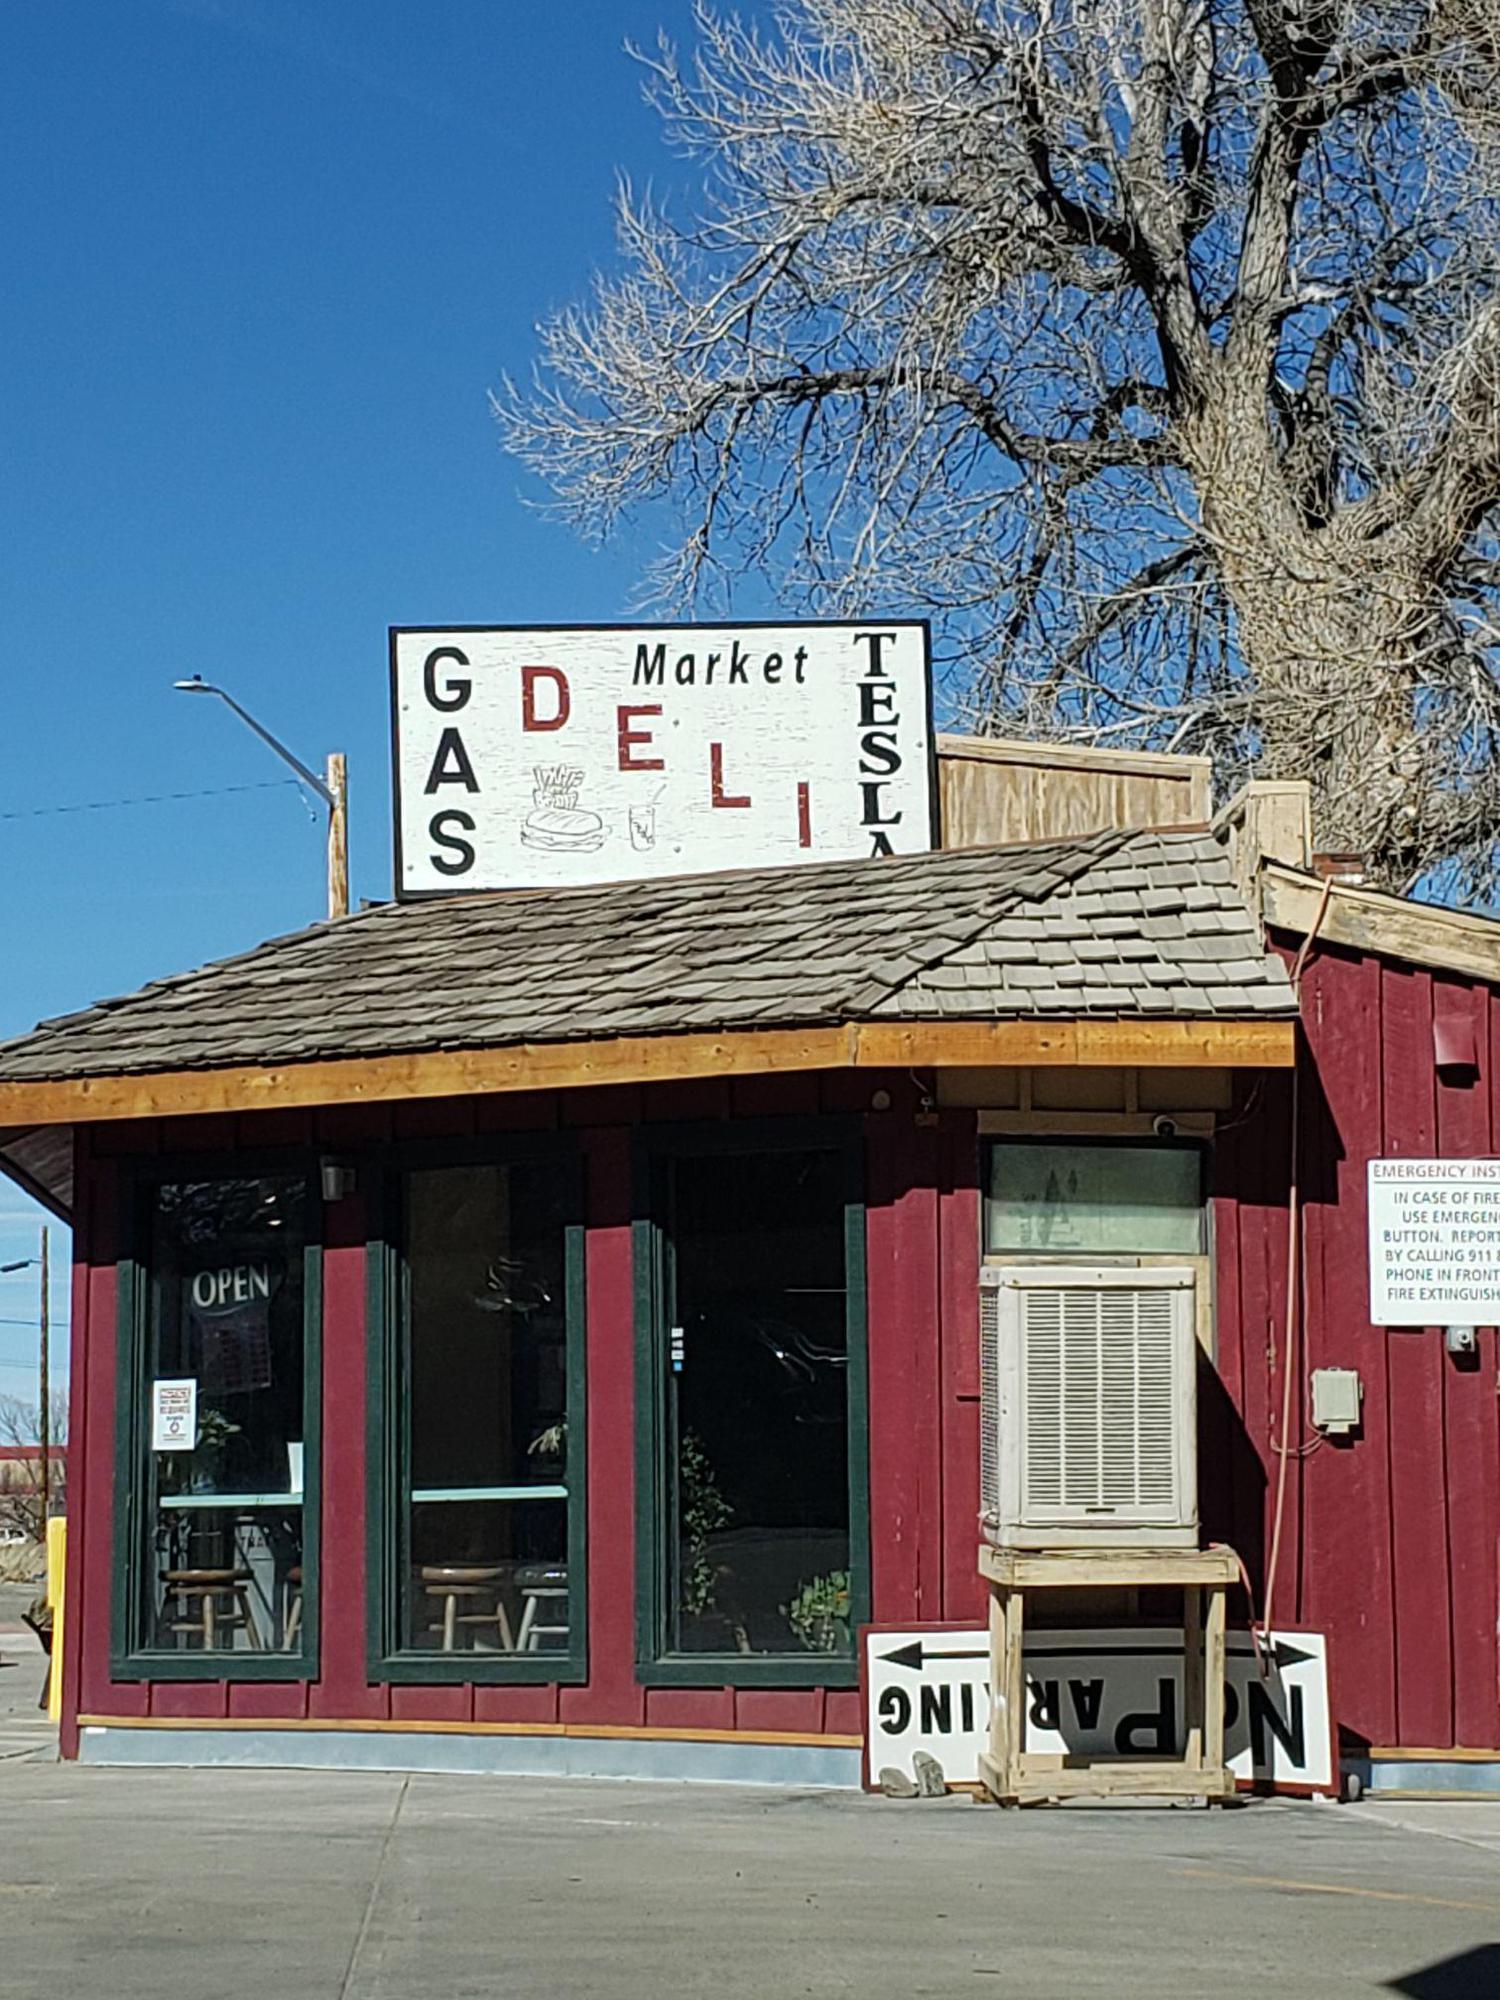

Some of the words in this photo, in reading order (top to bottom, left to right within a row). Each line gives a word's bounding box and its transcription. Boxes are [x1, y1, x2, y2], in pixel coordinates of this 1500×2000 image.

[632, 640, 809, 686] Market
[423, 646, 481, 876] GAS
[520, 665, 812, 848] DELI
[1373, 1163, 1467, 1178] EMERGENCY
[1393, 1192, 1409, 1205] IN
[1412, 1192, 1447, 1205] CASE
[1451, 1192, 1469, 1205] OF
[1402, 1210, 1428, 1223] USE
[1432, 1210, 1500, 1223] EMERGEN
[1383, 1229, 1443, 1243] BUTTON.
[1385, 1249, 1403, 1262] BY
[1406, 1249, 1465, 1262] CALLING
[1468, 1249, 1491, 1262] 911
[1386, 1268, 1433, 1281] PHONE
[1437, 1268, 1451, 1281] IN
[1455, 1268, 1500, 1282] FRONT
[192, 1262, 270, 1308] OPEN
[1387, 1287, 1415, 1301] FIRE
[877, 1677, 1177, 1755] PARING
